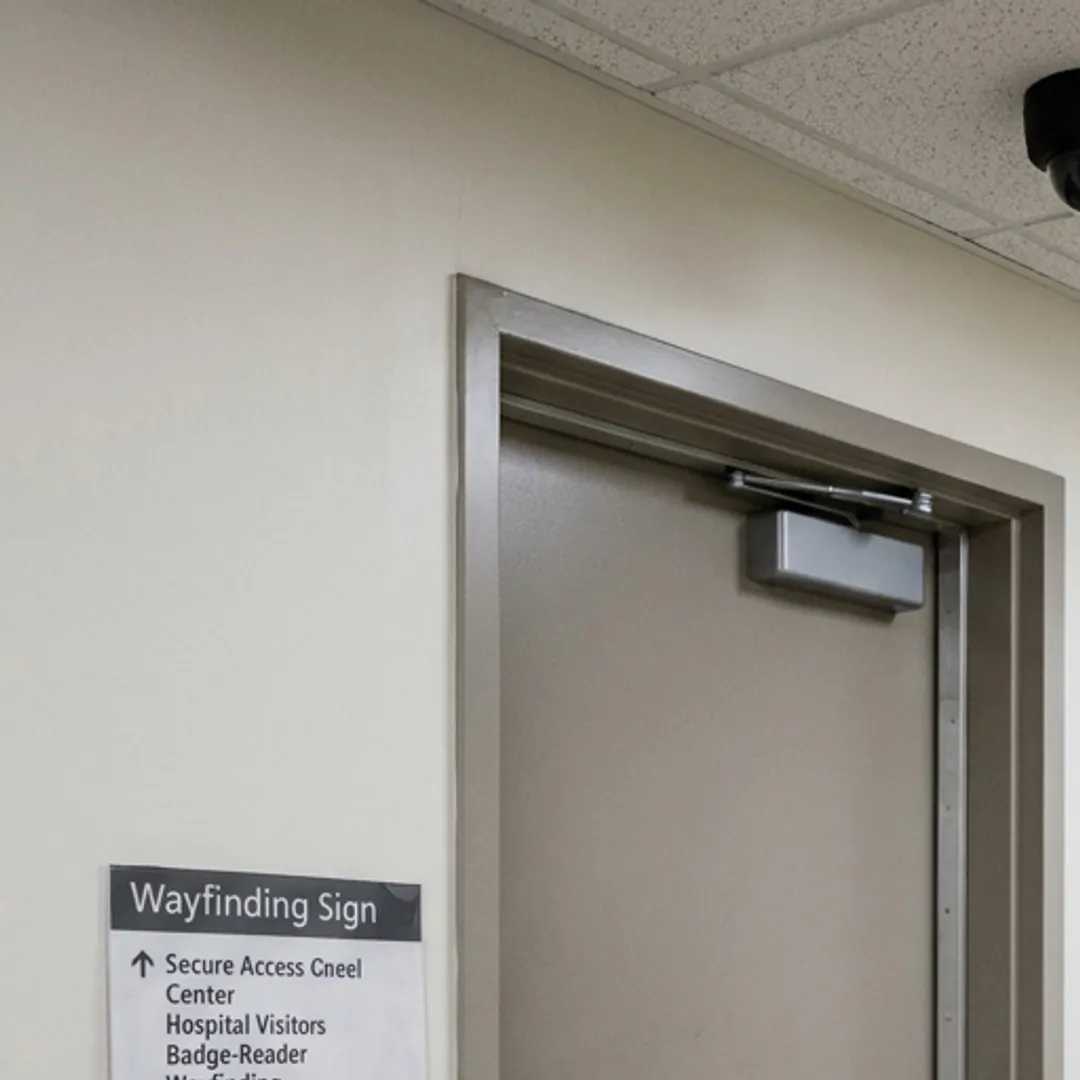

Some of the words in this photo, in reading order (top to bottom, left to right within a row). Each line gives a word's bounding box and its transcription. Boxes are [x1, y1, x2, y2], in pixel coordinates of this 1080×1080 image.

[131, 882, 308, 928] Wayfinding
[319, 892, 376, 929] Sign
[166, 953, 234, 975] Secure
[240, 956, 304, 977] Access
[166, 983, 235, 1005] Center
[167, 1013, 249, 1040] Hospital
[256, 1014, 326, 1035] Visitors
[167, 1044, 307, 1070] Badge-Reader
